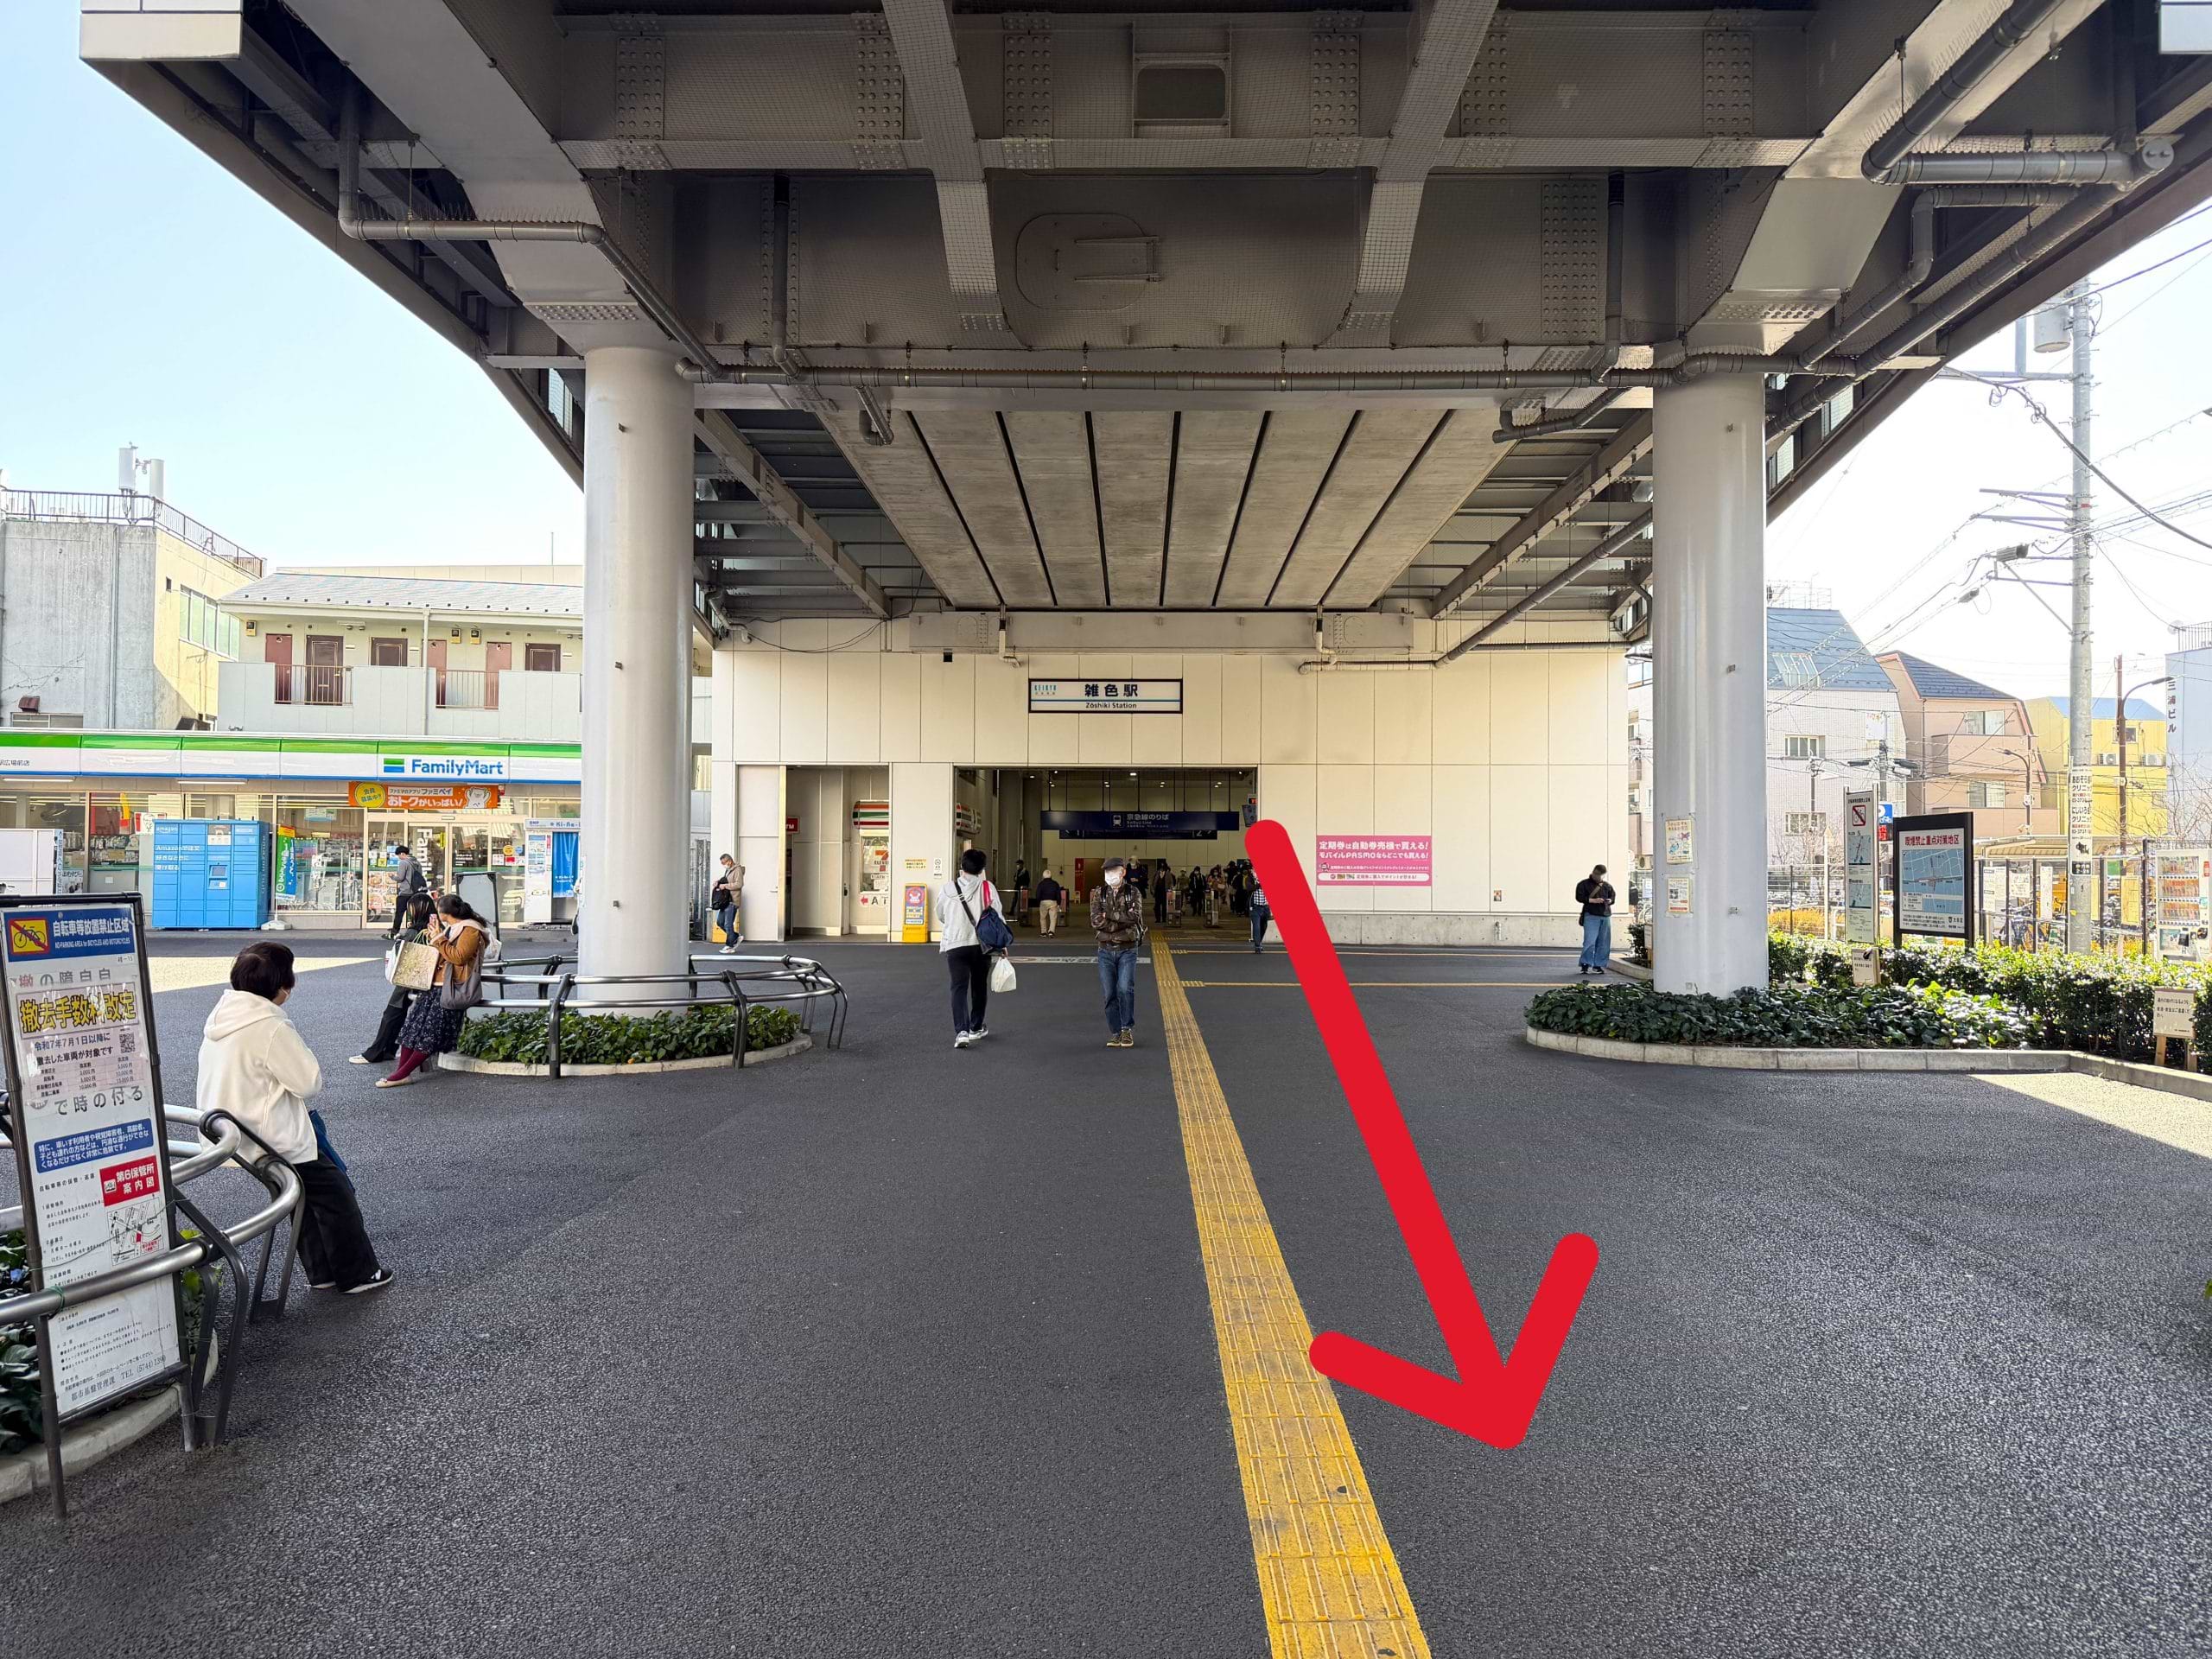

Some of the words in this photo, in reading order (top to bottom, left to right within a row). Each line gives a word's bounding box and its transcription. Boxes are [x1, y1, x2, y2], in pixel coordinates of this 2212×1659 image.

[1084, 683, 1138, 697] 雑色駅
[411, 759, 503, 775] FamilyMart
[53, 917, 130, 938] 自転車等放置禁止区域
[116, 1163, 155, 1183] 第6保管所
[120, 1369, 134, 1381] TEL
